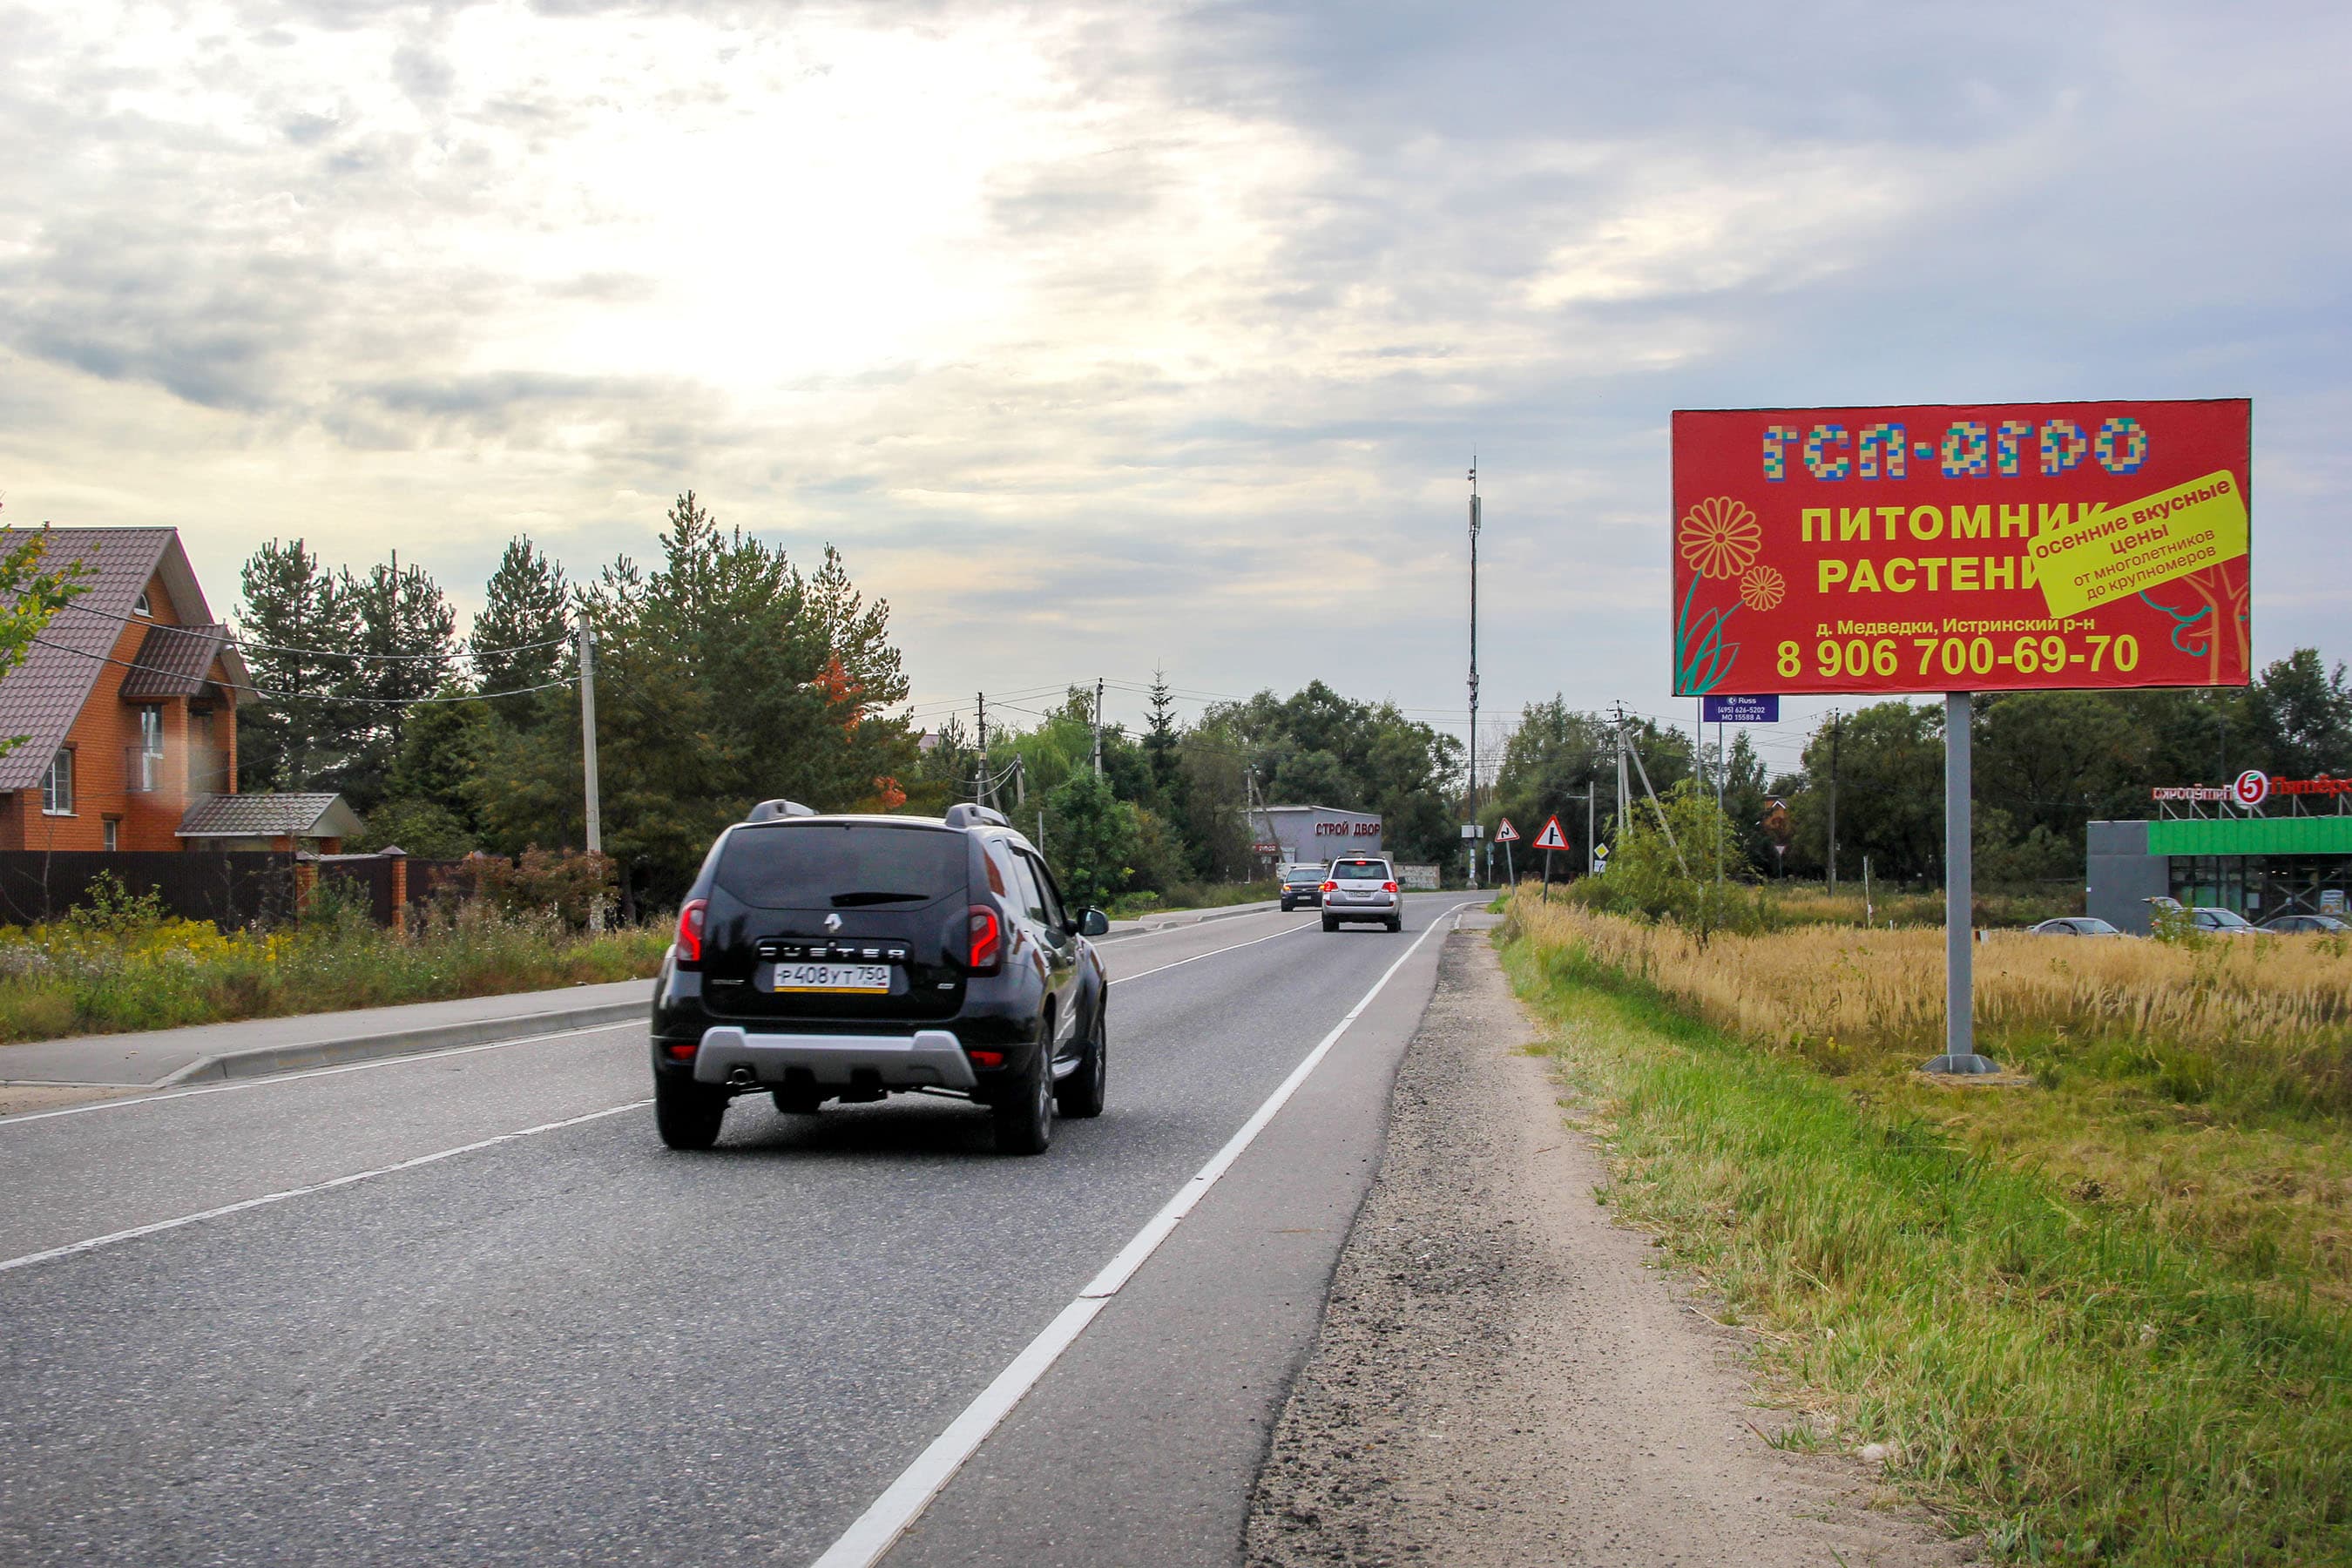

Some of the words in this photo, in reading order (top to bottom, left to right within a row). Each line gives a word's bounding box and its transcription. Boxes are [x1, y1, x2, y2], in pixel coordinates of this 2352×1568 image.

[2035, 517, 2129, 558] осенние
[2132, 480, 2231, 525] вкусные
[2111, 524, 2170, 556] цены
[2073, 571, 2092, 587] от
[2093, 528, 2215, 582] многолетников
[2087, 585, 2105, 601] до
[2108, 545, 2217, 591] крупномеров
[1816, 623, 1832, 637] д.
[1837, 619, 1938, 636] Медведки,
[1943, 617, 2059, 633] Истринский
[2064, 618, 2095, 633] р-н
[1776, 640, 1801, 678] 8
[1817, 639, 1897, 677] 906
[1914, 634, 2139, 675] 700-69-70
[1315, 821, 1348, 835] СТРОЙ
[1352, 823, 1381, 836] ДВОР
[760, 946, 906, 958] DUSTER
[856, 967, 887, 981] 750
